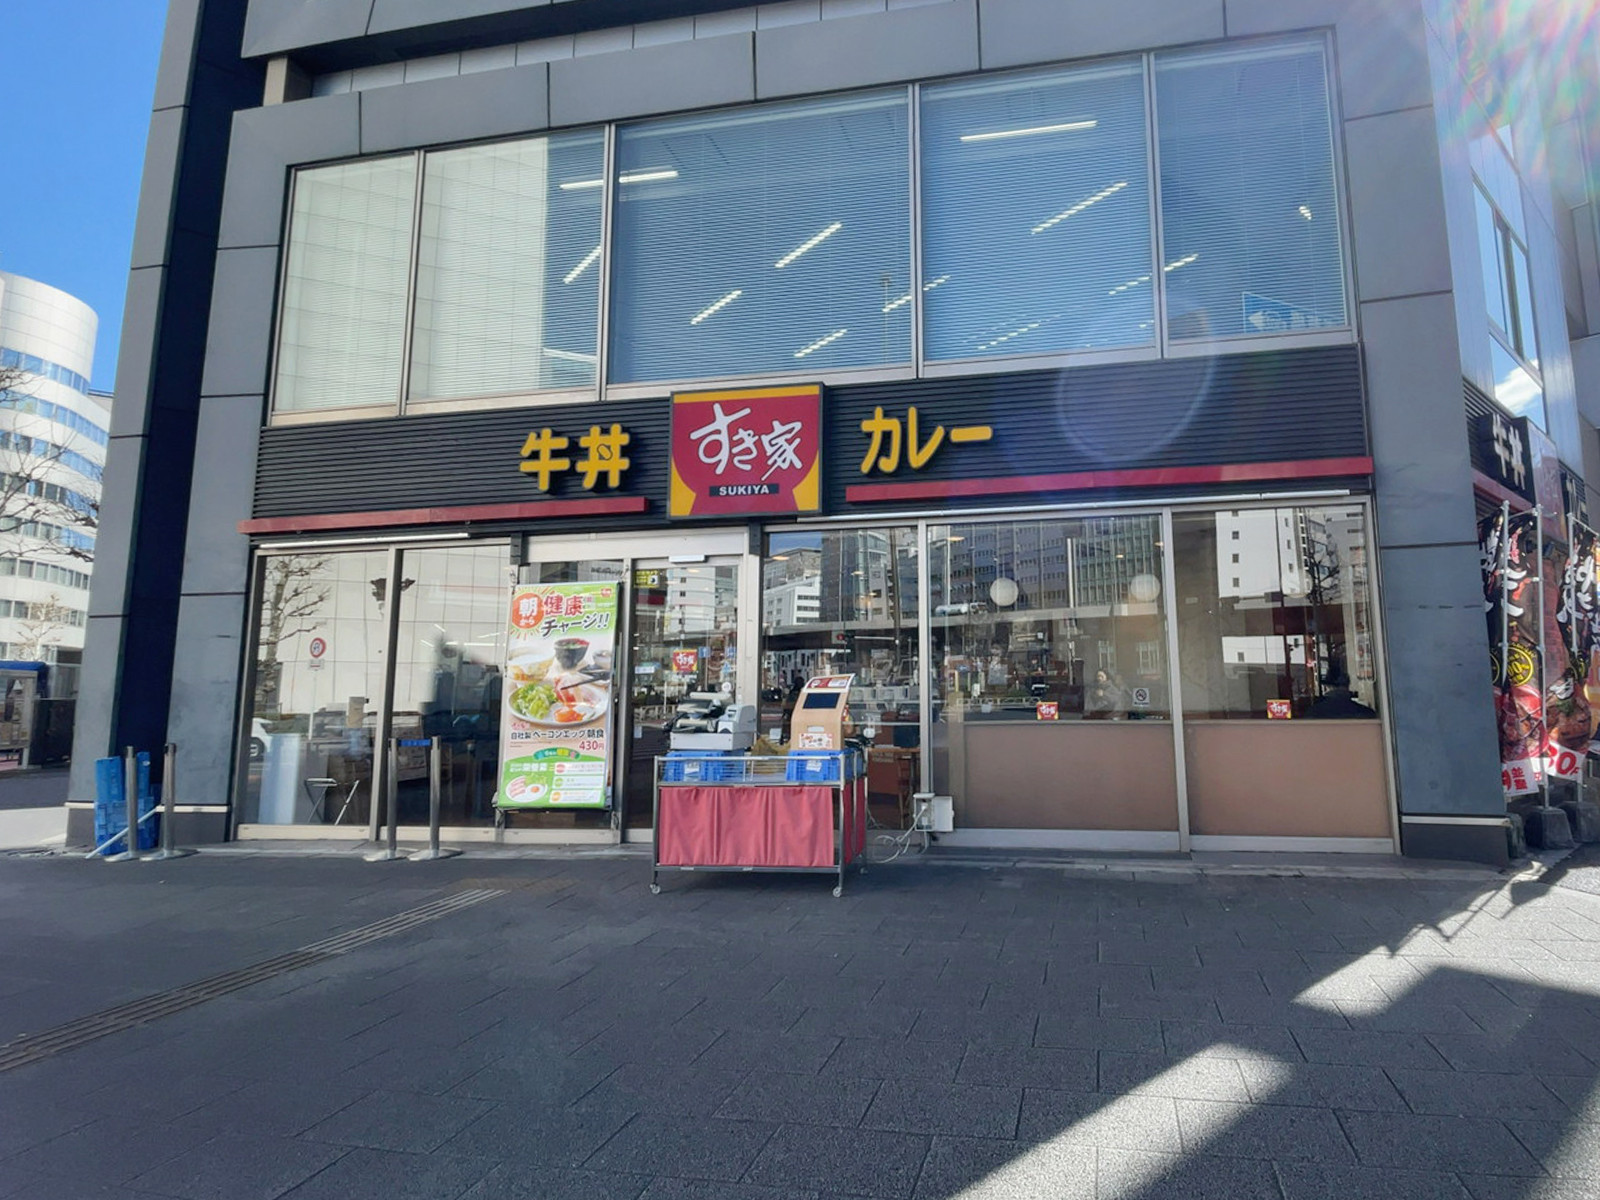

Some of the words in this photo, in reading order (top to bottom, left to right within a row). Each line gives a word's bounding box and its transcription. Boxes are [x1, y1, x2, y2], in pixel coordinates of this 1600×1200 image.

[519, 426, 630, 492] 牛丼
[689, 402, 804, 482] すき家
[860, 406, 994, 475] カレー
[718, 485, 771, 497] SUKIYA
[519, 597, 539, 617] 朝
[544, 595, 583, 616] 健康
